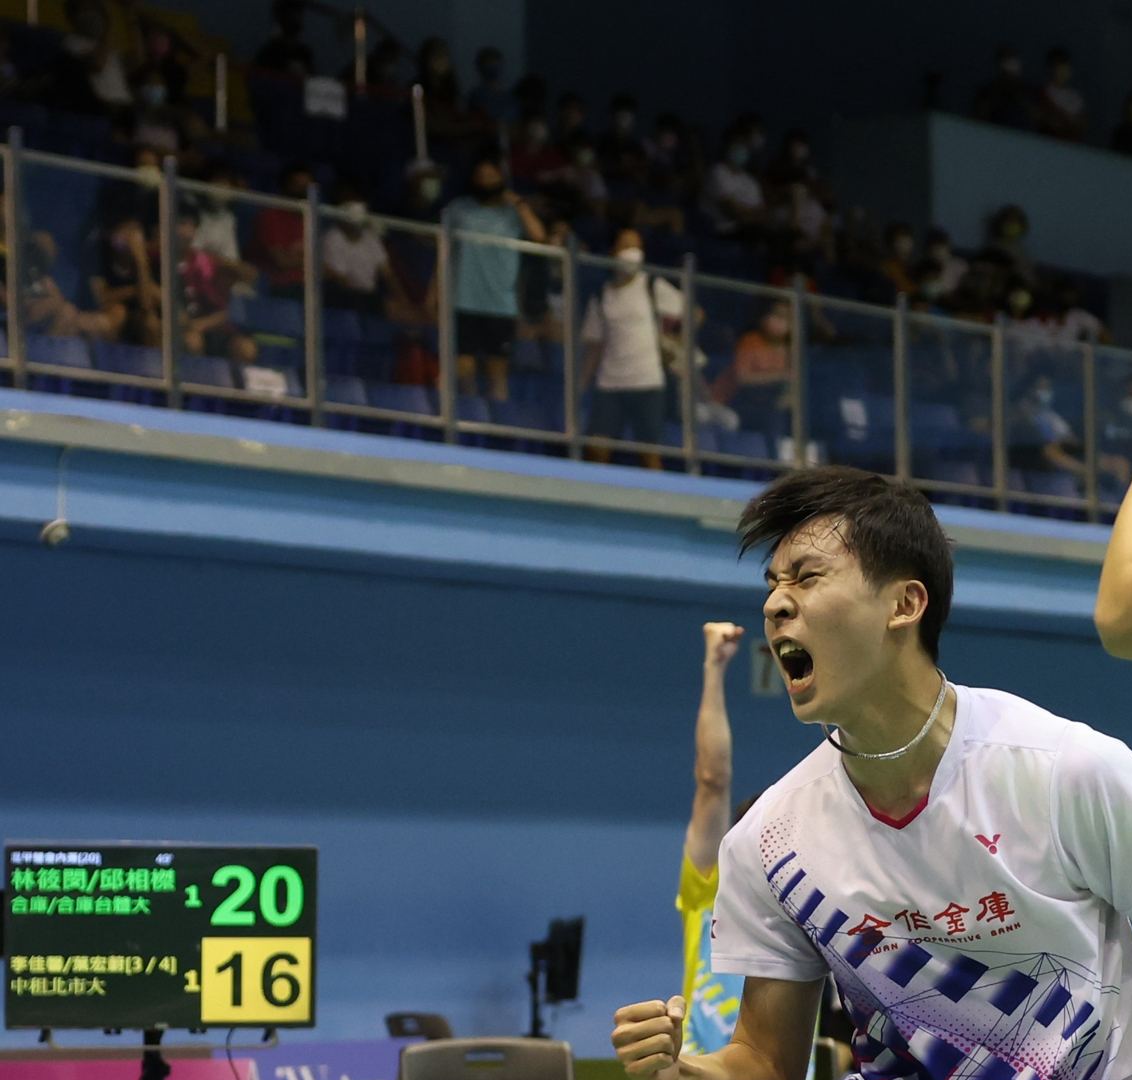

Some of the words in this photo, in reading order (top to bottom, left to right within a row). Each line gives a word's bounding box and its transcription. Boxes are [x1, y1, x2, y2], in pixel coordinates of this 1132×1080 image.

[184, 885, 202, 908] 1
[210, 865, 304, 927] 20
[908, 934, 982, 945] COOPERATIVE
[990, 921, 1022, 937] BANK
[184, 969, 200, 993] 1
[216, 951, 301, 1008] 16
